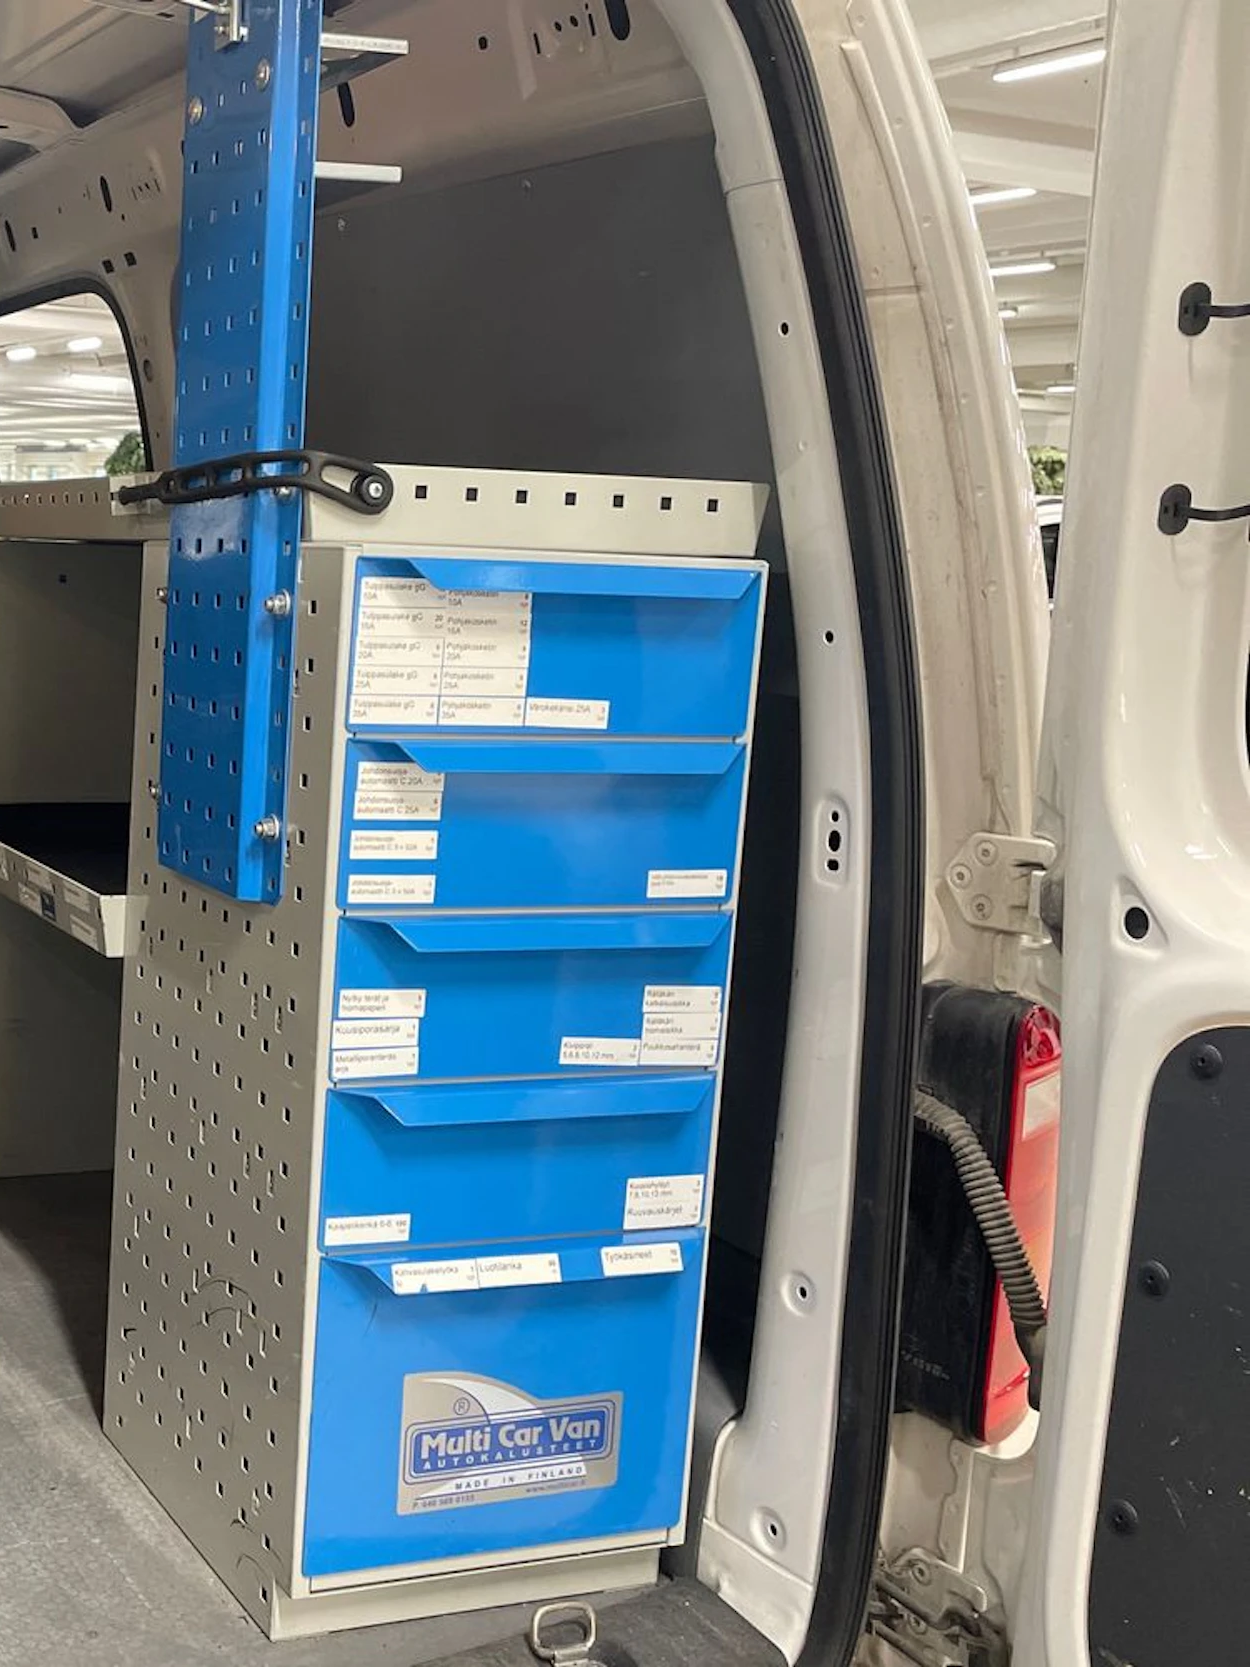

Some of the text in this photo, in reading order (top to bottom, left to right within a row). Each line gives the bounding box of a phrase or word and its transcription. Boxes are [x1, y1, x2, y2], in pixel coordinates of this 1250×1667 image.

[421, 1416, 601, 1459] Multi Car Van
[423, 1439, 597, 1470] AUTOKALUSTEET
[454, 1466, 583, 1491] MADE IN FINLAND
